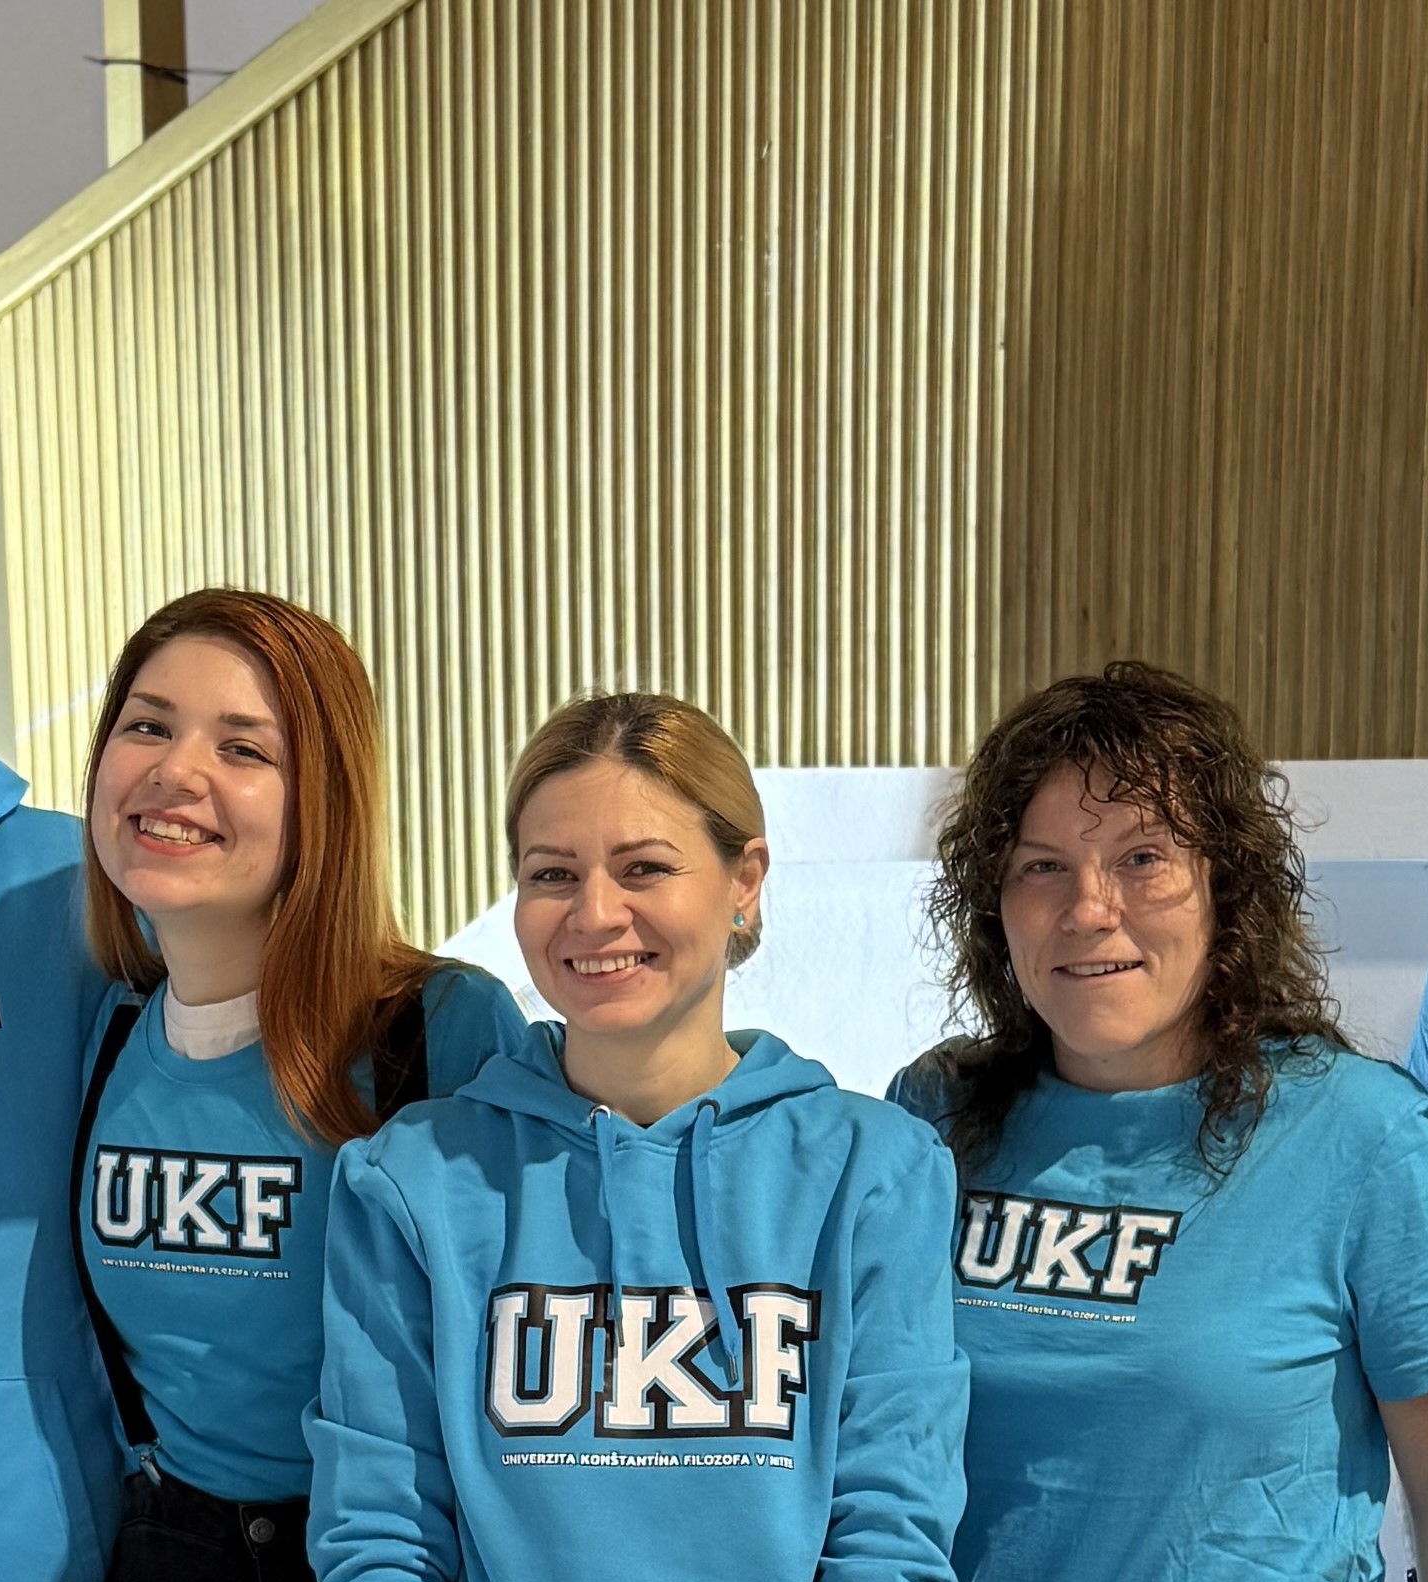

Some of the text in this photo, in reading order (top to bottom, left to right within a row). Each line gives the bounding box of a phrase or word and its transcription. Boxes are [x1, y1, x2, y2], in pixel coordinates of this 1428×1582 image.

[91, 1144, 302, 1259] UKF
[955, 1190, 1183, 1305] UKF
[485, 1283, 821, 1441] UKF
[502, 1452, 575, 1466] UNIVERZITA
[580, 1451, 679, 1467] KONŠTANTÍNA
[683, 1454, 750, 1466] FILOZOFA
[756, 1454, 766, 1466] V
